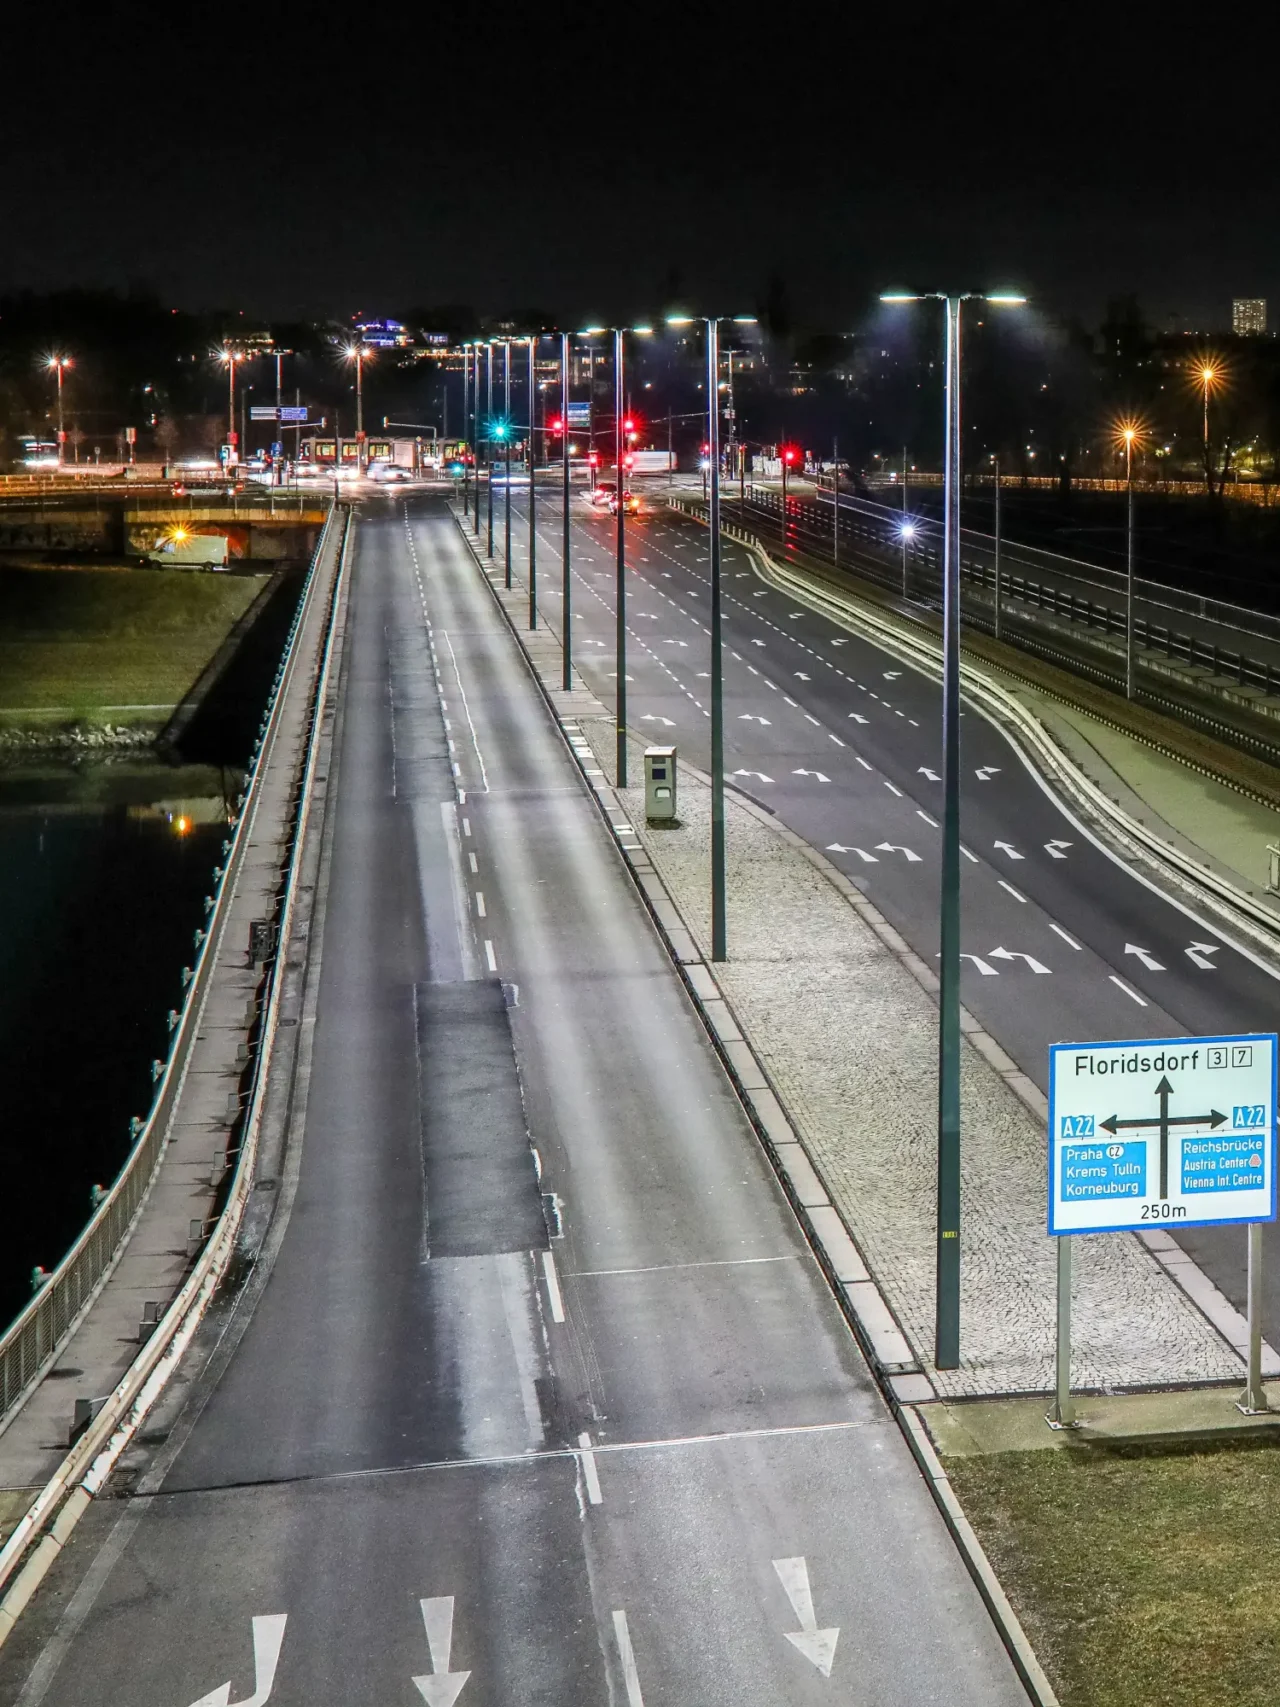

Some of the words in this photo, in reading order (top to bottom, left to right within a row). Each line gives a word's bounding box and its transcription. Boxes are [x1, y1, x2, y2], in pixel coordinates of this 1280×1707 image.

[1075, 1050, 1199, 1076] Floridsdorf
[1213, 1051, 1222, 1065] 3
[1237, 1050, 1247, 1064] 7
[1235, 1107, 1263, 1127] A22
[1062, 1117, 1093, 1137] A22
[1066, 1148, 1103, 1161] Praha
[1108, 1146, 1121, 1157] CZ
[1184, 1138, 1263, 1154] Reichsbrücke
[1066, 1165, 1108, 1179] Krems
[1113, 1162, 1141, 1176] Tulln
[1184, 1158, 1216, 1171] Austria
[1220, 1156, 1248, 1169] Center
[1066, 1181, 1139, 1197] Korneuburg
[1184, 1175, 1215, 1189] Vienna
[1217, 1174, 1231, 1186] Int.
[1233, 1173, 1262, 1186] Centre
[1141, 1203, 1187, 1219] 250m
